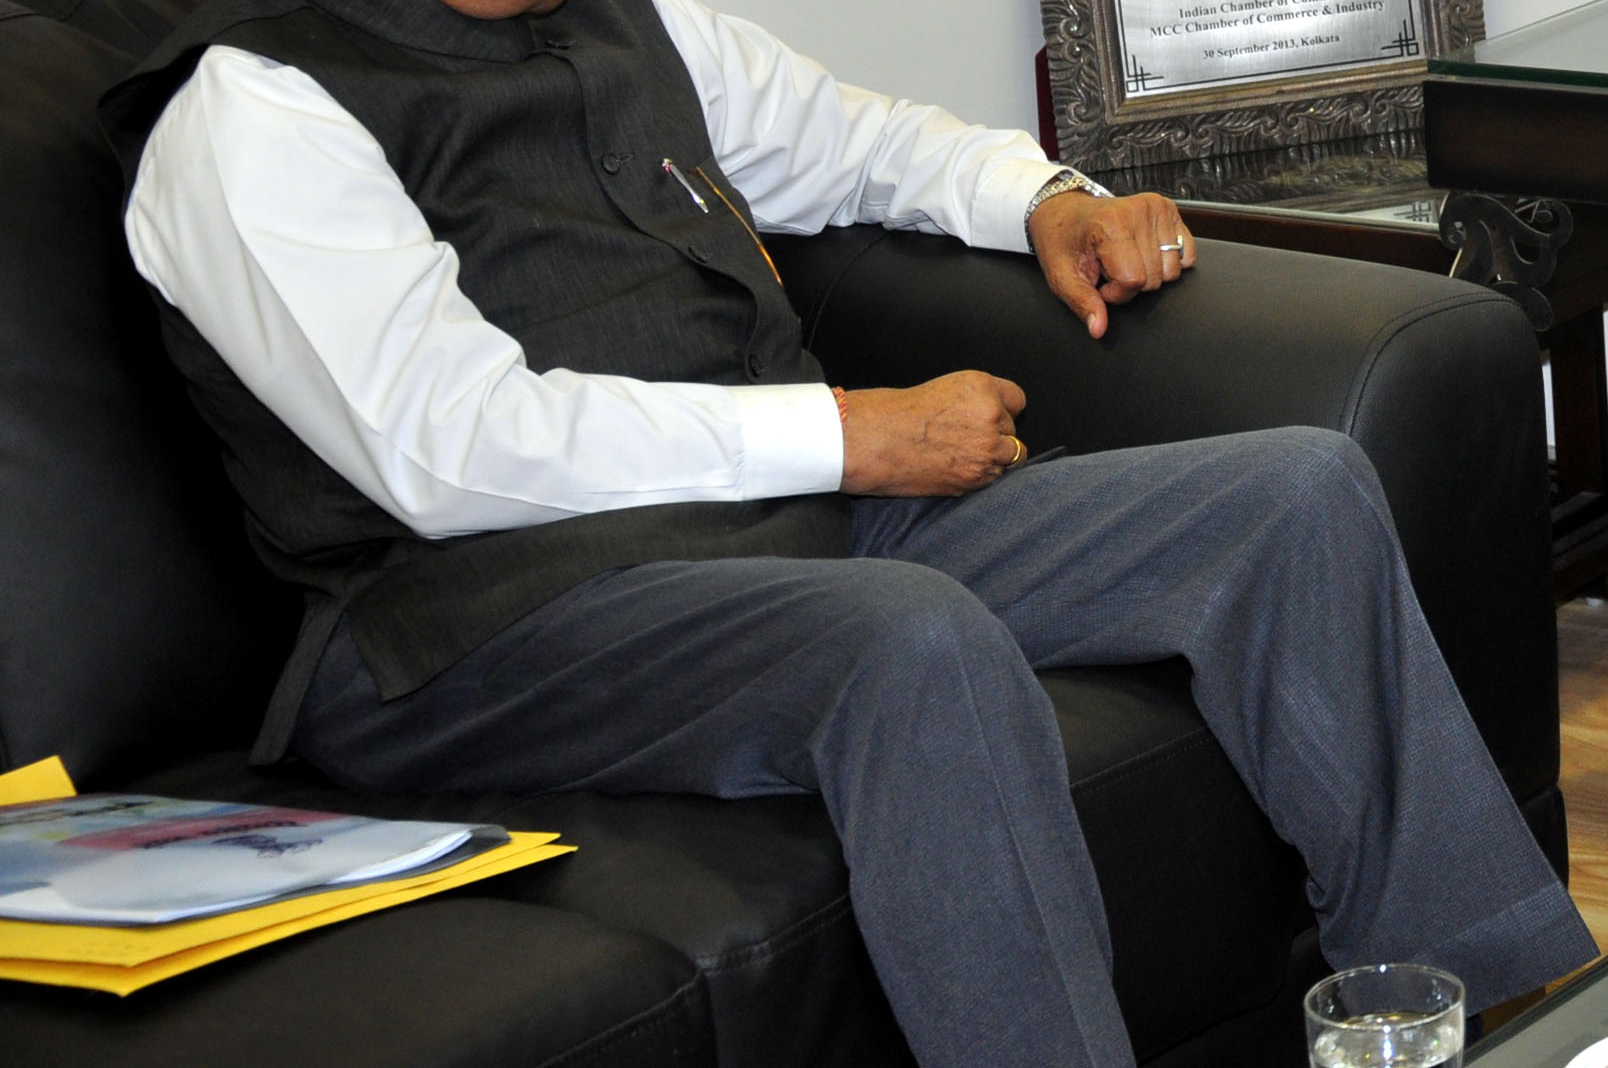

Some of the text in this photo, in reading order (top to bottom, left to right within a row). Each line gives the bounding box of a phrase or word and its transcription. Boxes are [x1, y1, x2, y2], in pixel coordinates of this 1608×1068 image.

[1150, 25, 1182, 38] MCC
[1185, 15, 1238, 32] Chamber
[1243, 13, 1253, 26] of
[1257, 9, 1318, 23] Commerce
[1321, 5, 1333, 15] &
[1179, 5, 1216, 19] Indian
[1203, 34, 1339, 59] 30 September 2013, Kolkata
